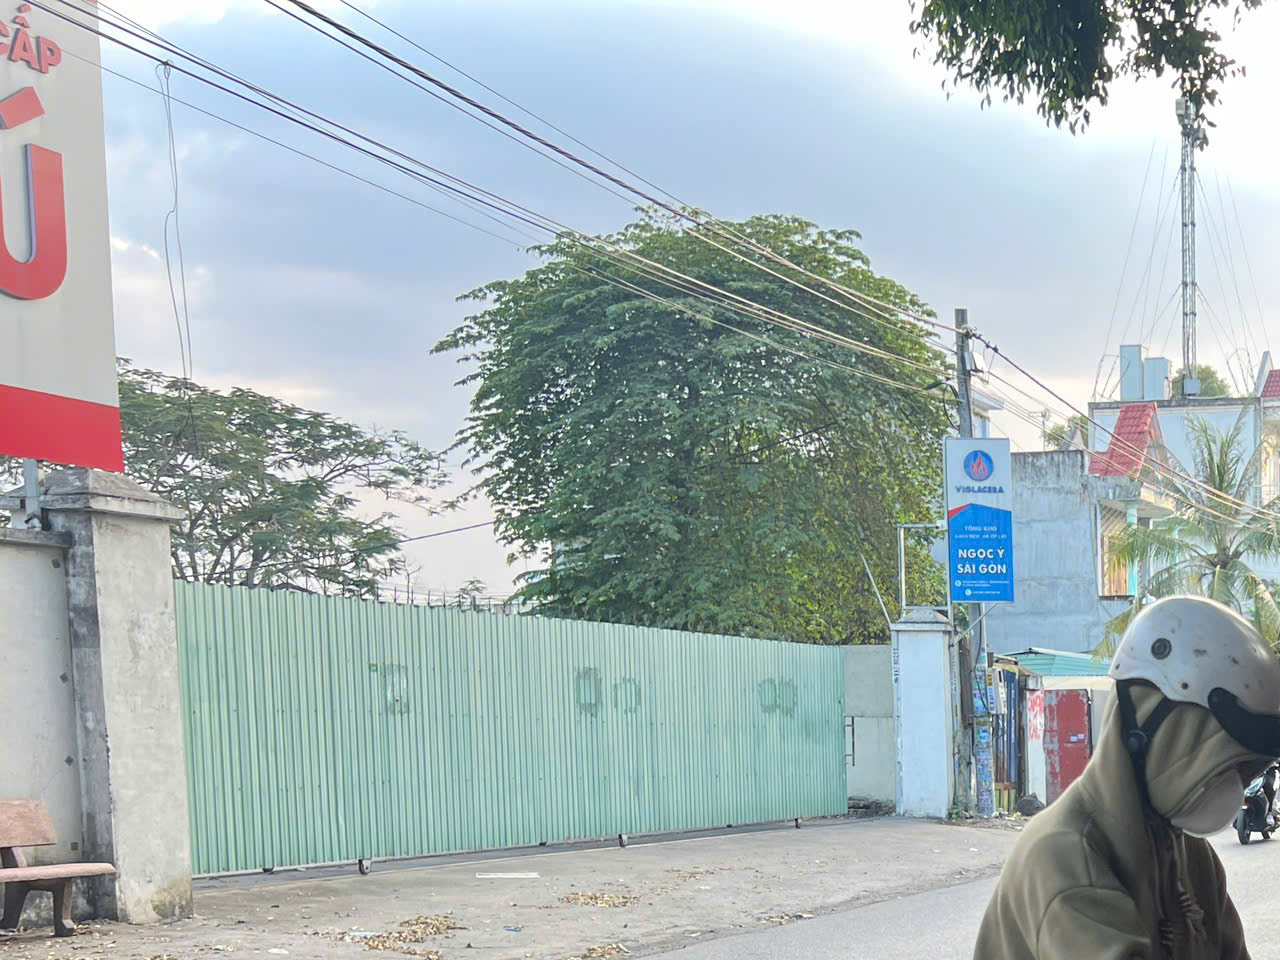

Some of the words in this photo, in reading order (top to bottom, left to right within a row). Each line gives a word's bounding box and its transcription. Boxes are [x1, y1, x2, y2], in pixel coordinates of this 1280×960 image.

[958, 548, 994, 560] NGỌC
[997, 546, 1005, 558] Ý
[957, 561, 976, 574] SÀI
[978, 561, 1007, 574] GÒN
